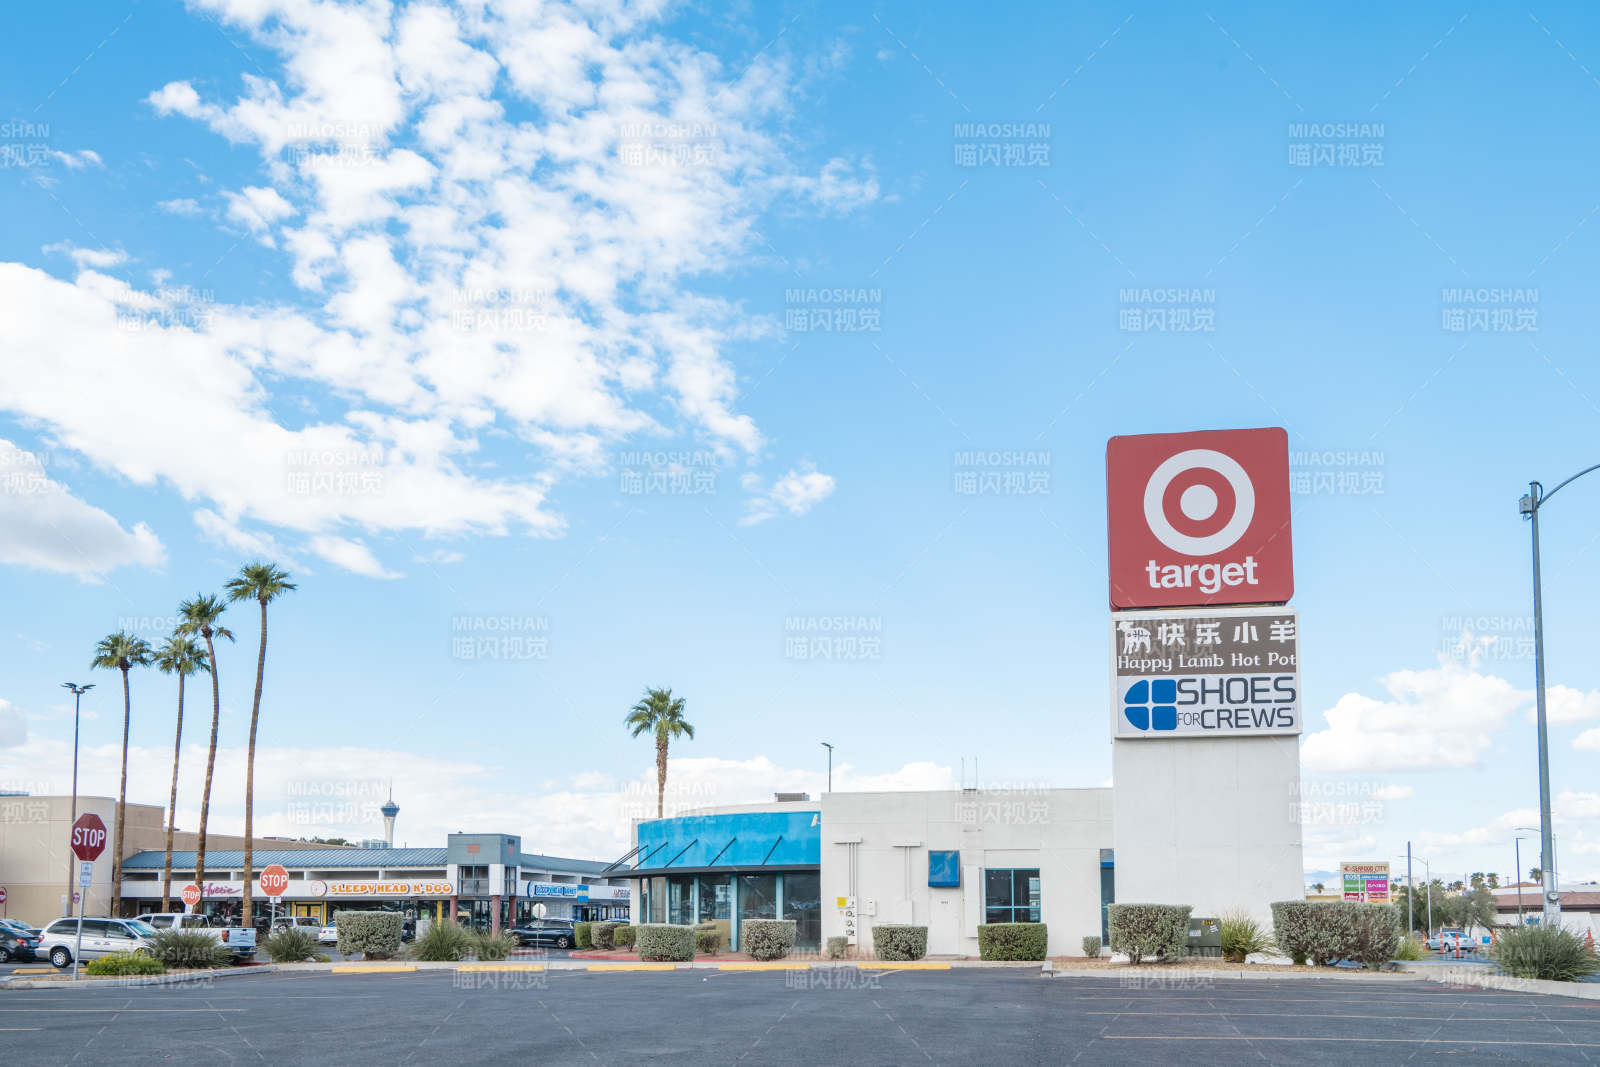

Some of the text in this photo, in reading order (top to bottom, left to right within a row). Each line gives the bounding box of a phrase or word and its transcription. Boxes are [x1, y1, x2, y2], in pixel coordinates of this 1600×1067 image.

[1145, 556, 1258, 594] target
[1157, 620, 1296, 646] 快乐小羊
[1118, 652, 1297, 672] Happy Lamb Hot Pot
[1177, 676, 1297, 706] SHOES
[1177, 707, 1295, 729] FOR CREWS
[73, 826, 105, 847] STOP
[262, 874, 288, 888] STOP
[330, 883, 408, 894] SLEEPYHEAD
[183, 890, 200, 900] STOP
